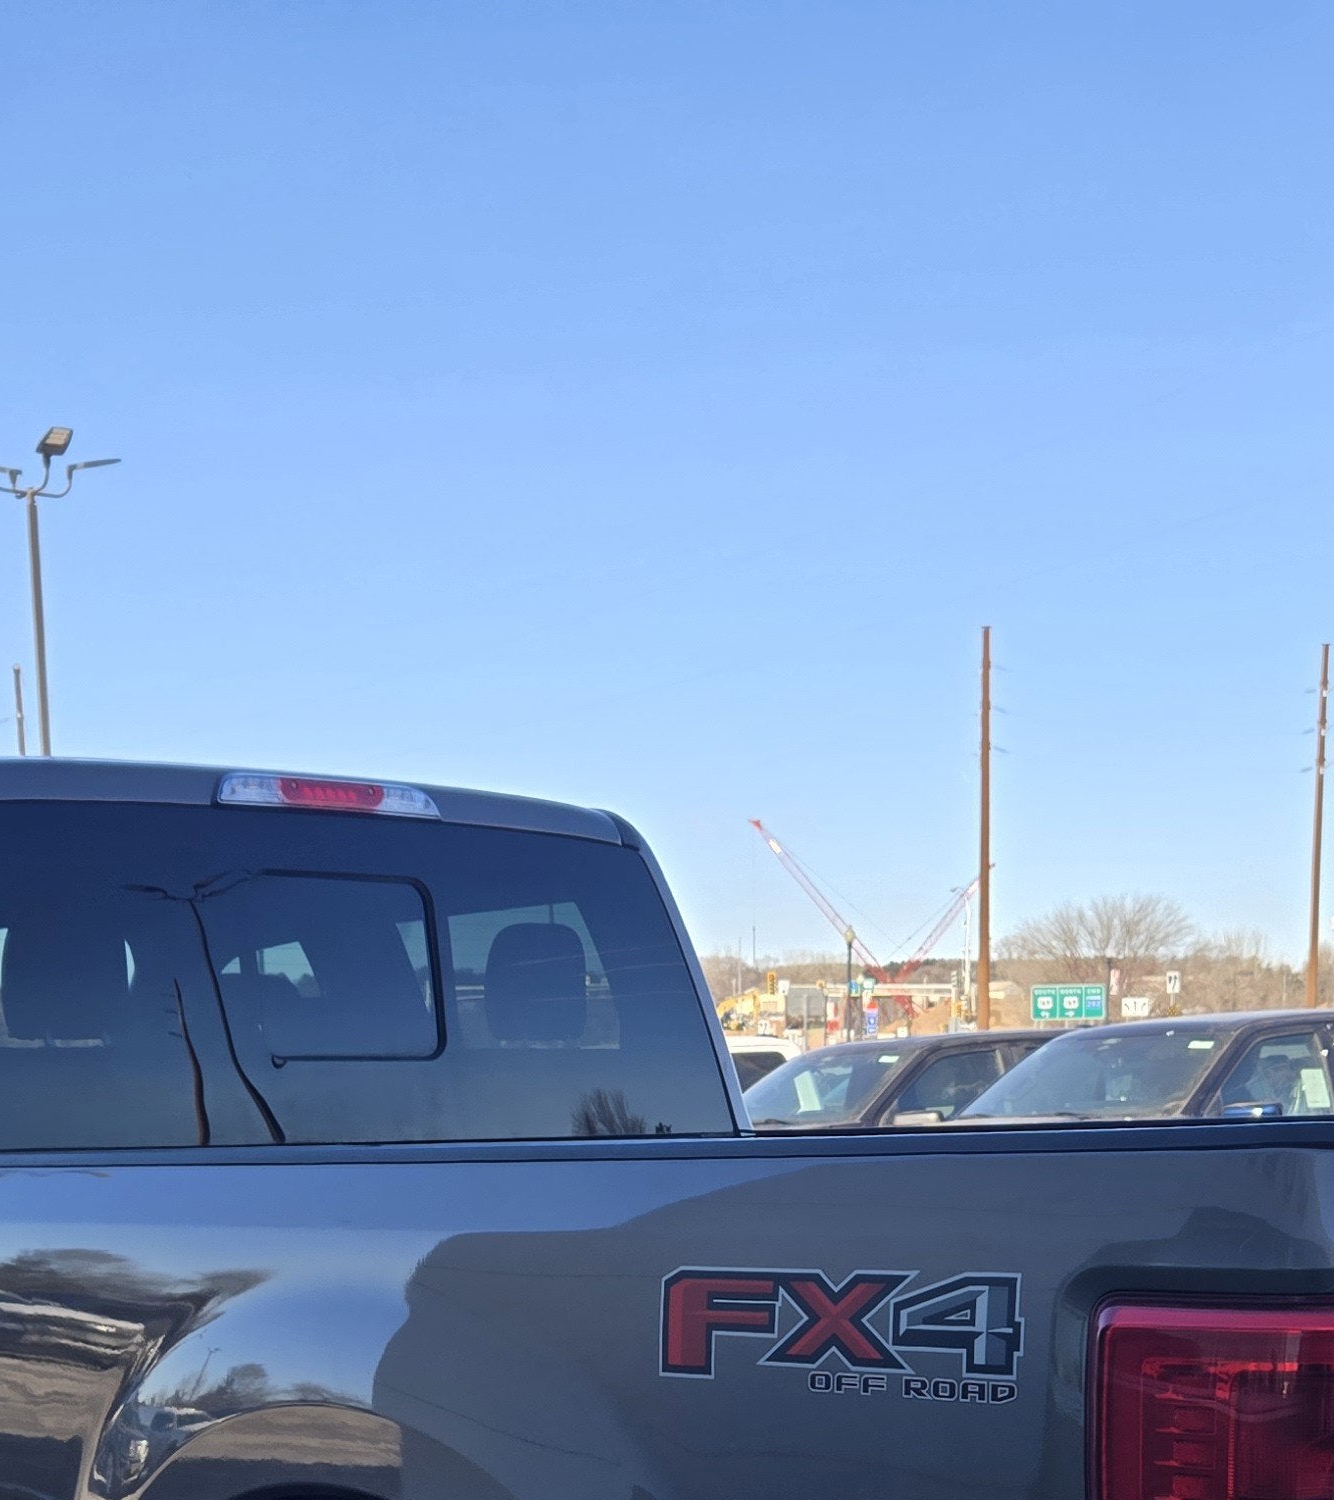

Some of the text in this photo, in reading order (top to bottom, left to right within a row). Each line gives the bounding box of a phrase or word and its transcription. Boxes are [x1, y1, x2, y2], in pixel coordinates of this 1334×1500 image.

[659, 1265, 1025, 1379] FX4
[807, 1370, 1018, 1405] OFF ROAD
